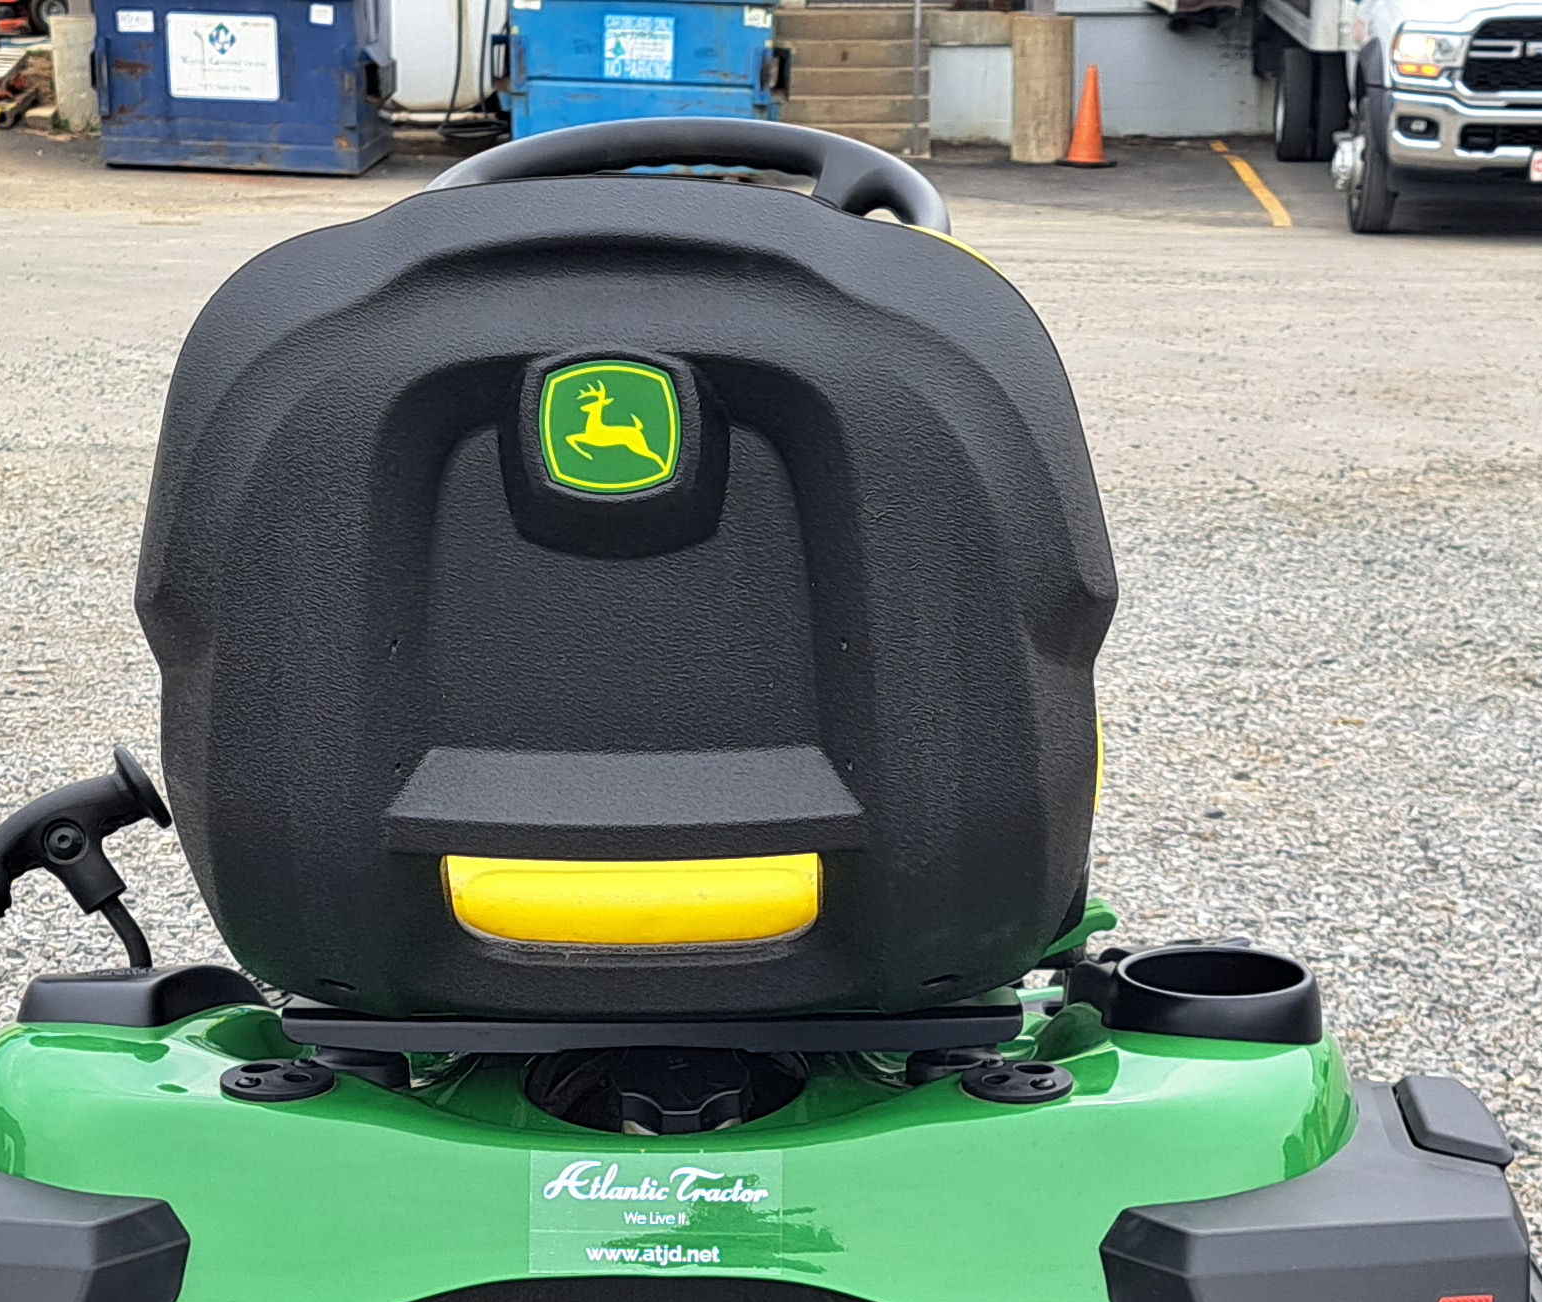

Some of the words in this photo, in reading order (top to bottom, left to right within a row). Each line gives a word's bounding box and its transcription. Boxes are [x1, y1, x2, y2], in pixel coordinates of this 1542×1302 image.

[543, 1160, 669, 1201] Atlantic
[669, 1166, 769, 1203] Tractor
[623, 1211, 647, 1225] We
[649, 1211, 676, 1225] Live
[585, 1245, 721, 1266] www.atjd.net
